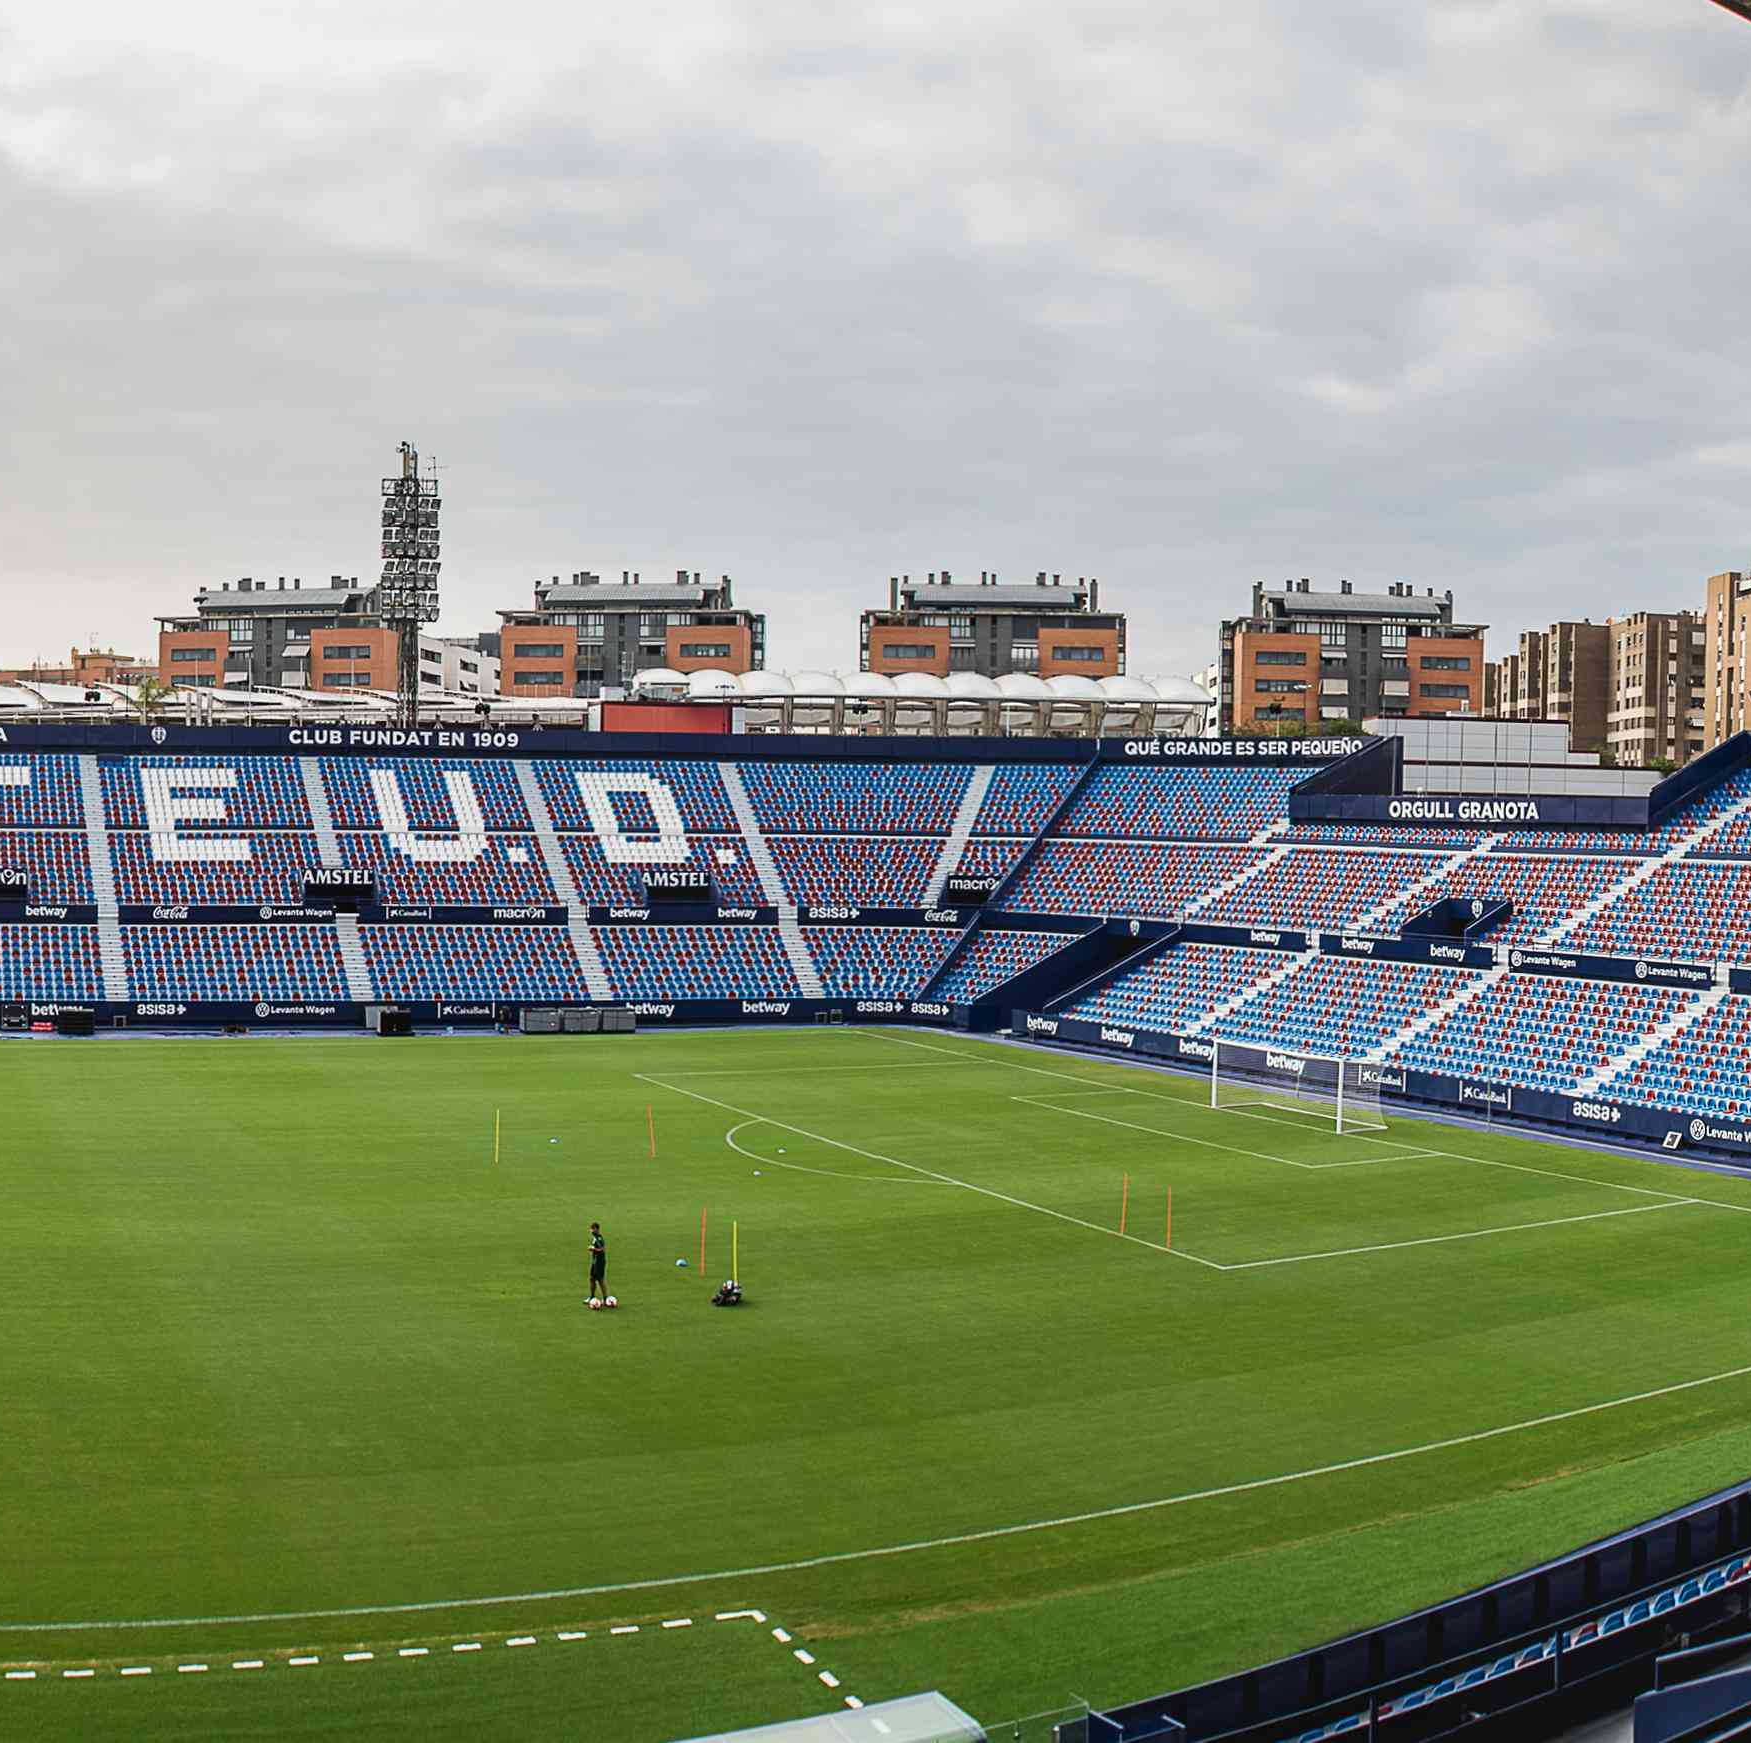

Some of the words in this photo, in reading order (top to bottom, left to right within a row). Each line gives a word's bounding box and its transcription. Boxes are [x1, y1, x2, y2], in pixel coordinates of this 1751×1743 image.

[289, 730, 342, 745] CLUB
[350, 731, 433, 746] FUNDAT
[438, 732, 465, 747] EN
[472, 732, 519, 748] 1909
[1124, 738, 1160, 757] QUÉ
[1164, 740, 1232, 756] GRANDE
[1236, 740, 1255, 755] ES
[1259, 740, 1289, 755] SER
[1292, 737, 1363, 758] PEQUEÑO
[1389, 801, 1454, 820] ORGULL
[1459, 801, 1539, 820] GRANOTA
[303, 869, 372, 884] AMSTEL
[641, 871, 709, 886] AMSTEL
[25, 904, 67, 919] betway
[273, 908, 302, 917] Levante
[304, 908, 332, 918] Wagen
[493, 905, 546, 920] macron
[610, 907, 650, 919] betway
[718, 907, 757, 920] betway
[808, 905, 849, 918] asisa
[1250, 930, 1280, 945] betway
[1341, 937, 1374, 954] betway
[1429, 944, 1465, 961] betway
[1522, 954, 1549, 967] Levante
[1551, 956, 1576, 970] Wagen
[1647, 966, 1677, 979] Levante
[1679, 968, 1707, 983] Wagen
[137, 1003, 176, 1015] asisa
[270, 1004, 303, 1014] Levante
[305, 1004, 335, 1016] Wagen
[625, 1001, 674, 1017] betway
[742, 1001, 790, 1017] betway
[857, 1002, 893, 1013] asisa
[1027, 1015, 1058, 1034] betway
[1101, 1025, 1135, 1048] betway
[1179, 1038, 1214, 1060] betway
[1266, 1052, 1306, 1075] betway
[1573, 1101, 1610, 1120] asisa
[1706, 1125, 1742, 1142] Levante
